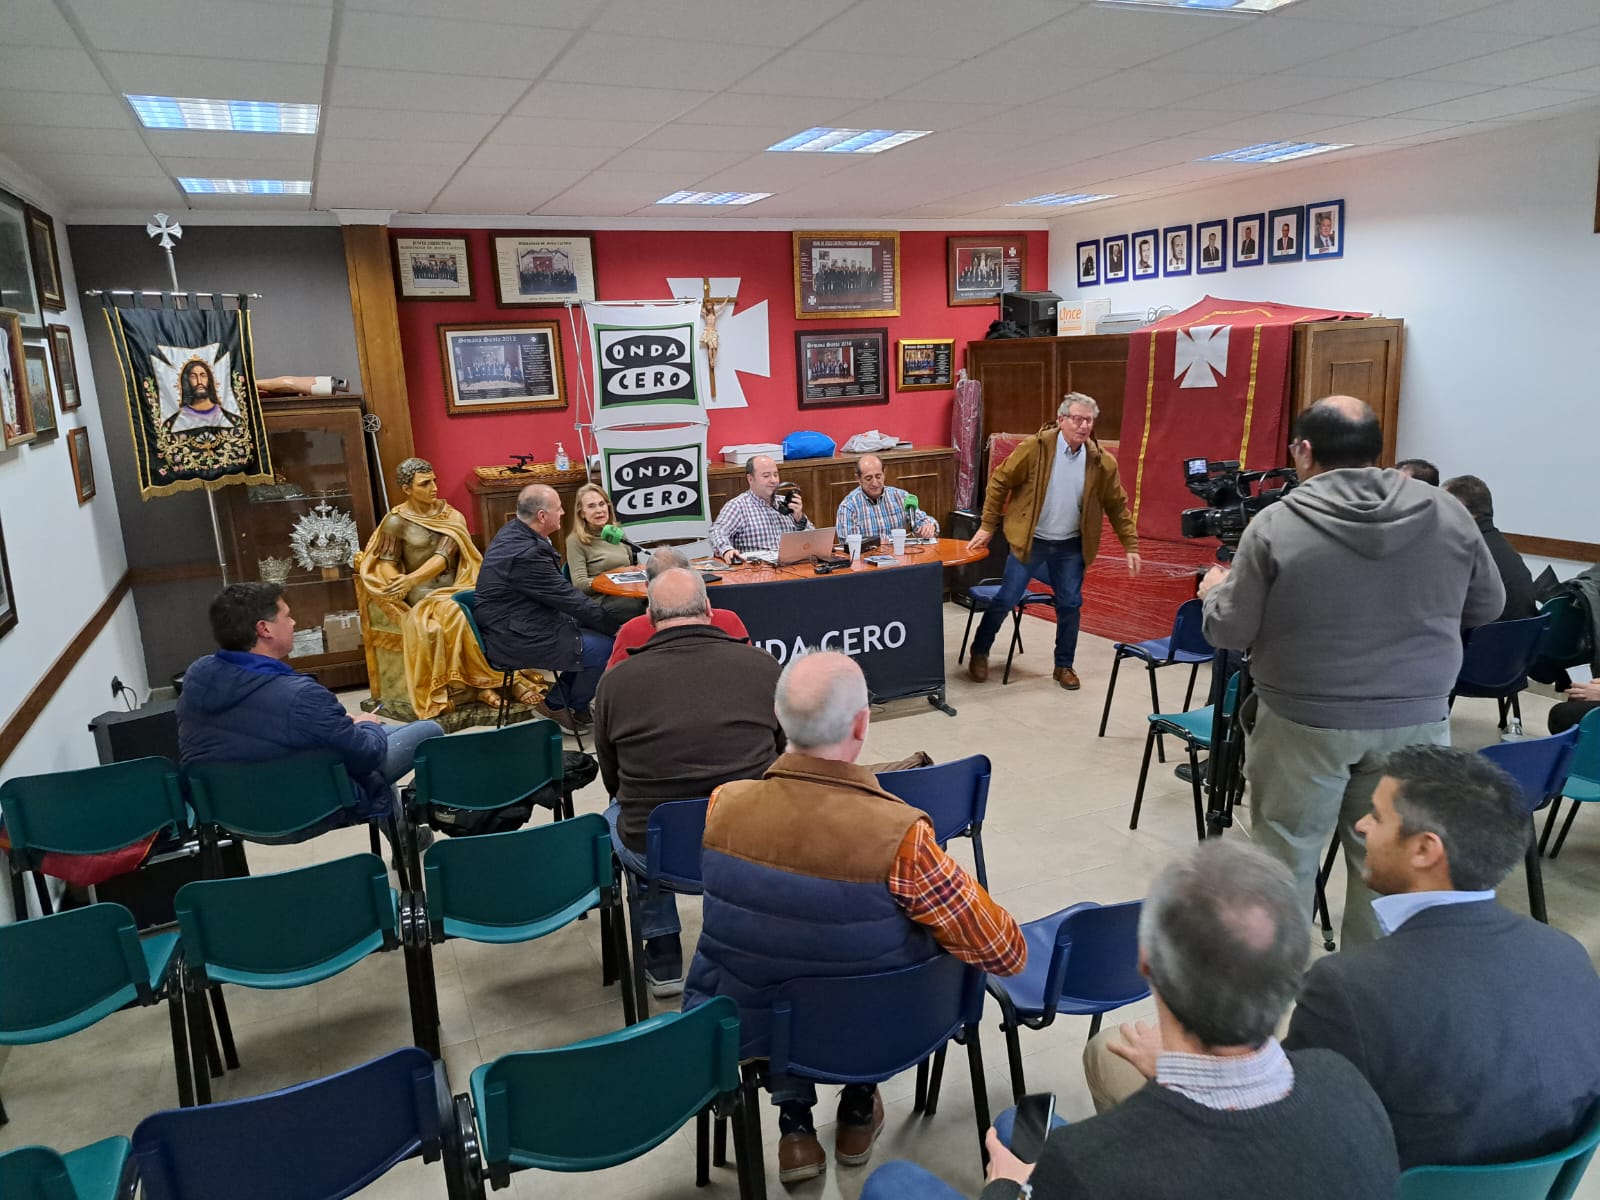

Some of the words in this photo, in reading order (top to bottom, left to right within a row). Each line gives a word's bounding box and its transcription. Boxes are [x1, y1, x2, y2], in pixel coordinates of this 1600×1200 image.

[612, 343, 679, 360] ONDA
[618, 371, 681, 390] CERO
[621, 463, 687, 481] ONDA
[627, 490, 688, 510] CERO
[755, 635, 809, 666] DA
[820, 620, 907, 657] CERO
